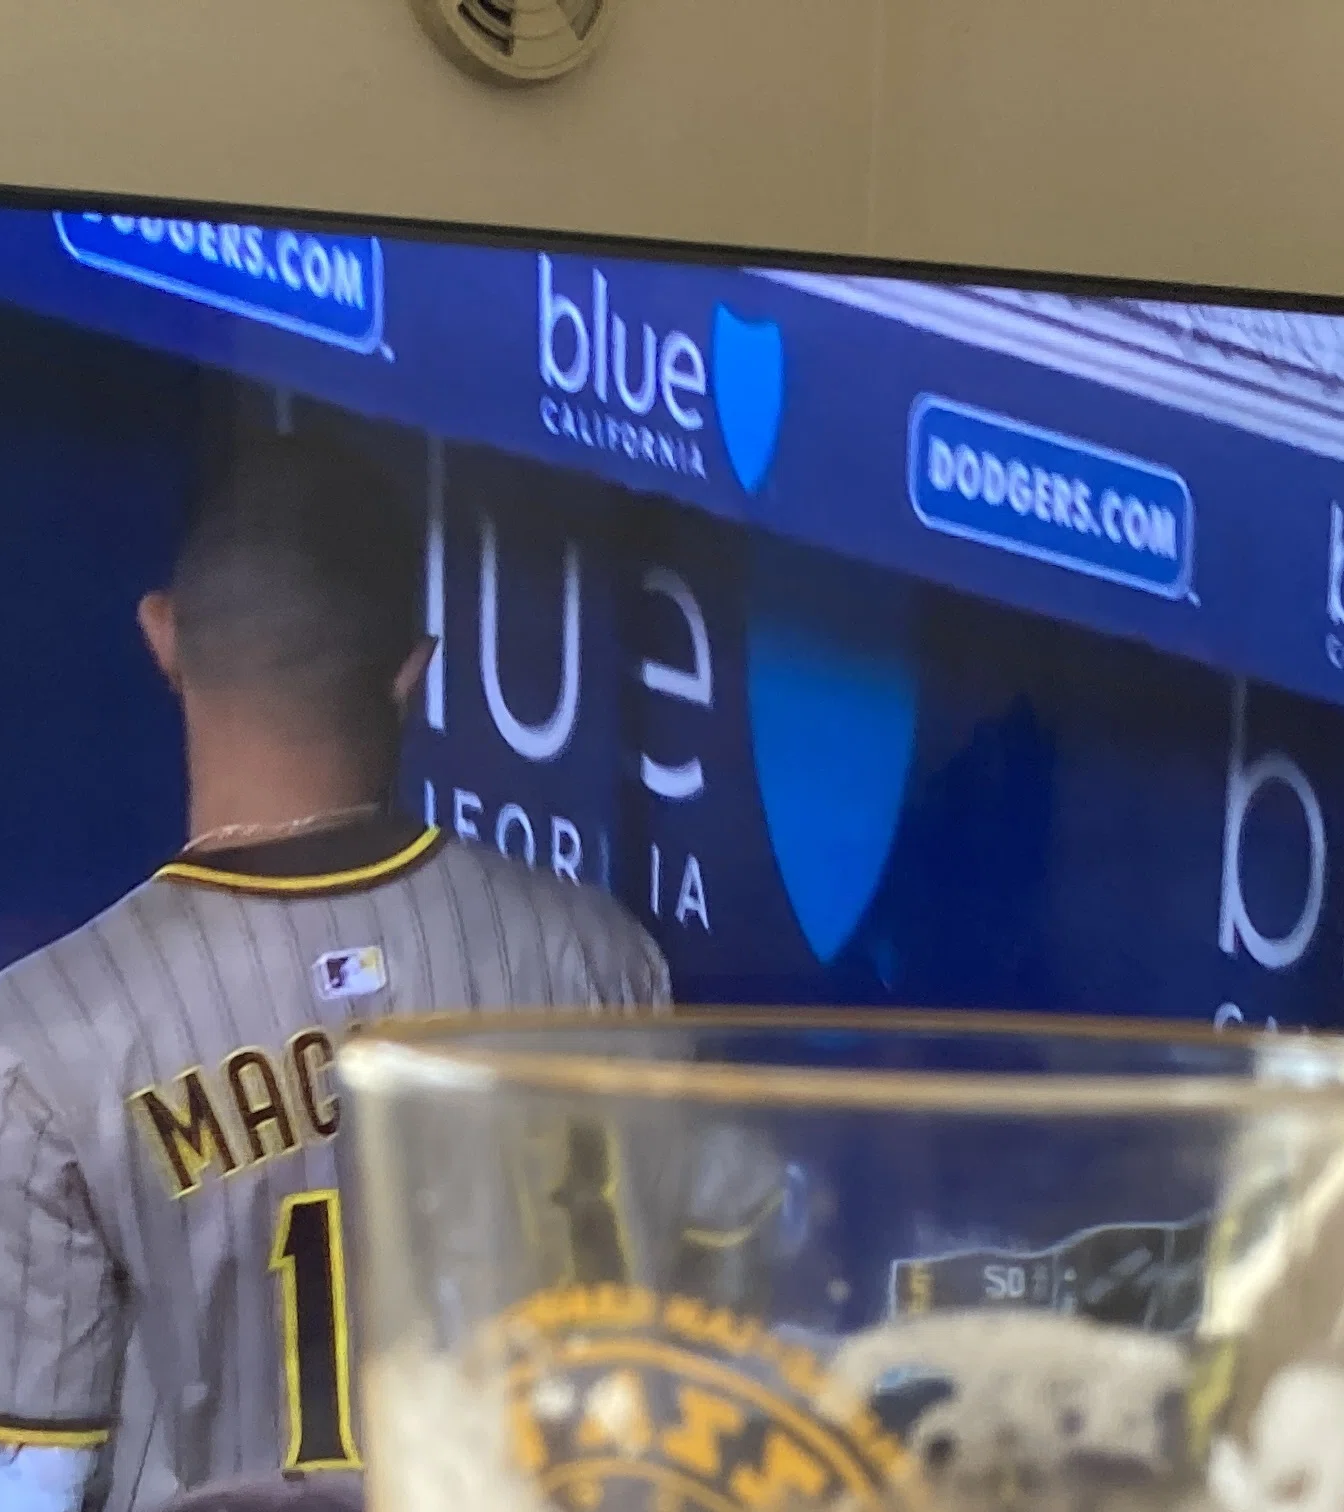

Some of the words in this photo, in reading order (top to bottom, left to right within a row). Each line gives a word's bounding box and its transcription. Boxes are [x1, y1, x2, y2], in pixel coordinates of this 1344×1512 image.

[81, 211, 366, 311] GERS.COM
[537, 251, 710, 433] blue
[539, 395, 709, 480] CALIFORNIA
[926, 433, 1178, 562] DODGERS.COM
[425, 440, 714, 800] lue
[130, 1028, 342, 1198] MAC
[268, 1188, 364, 1473] 1
